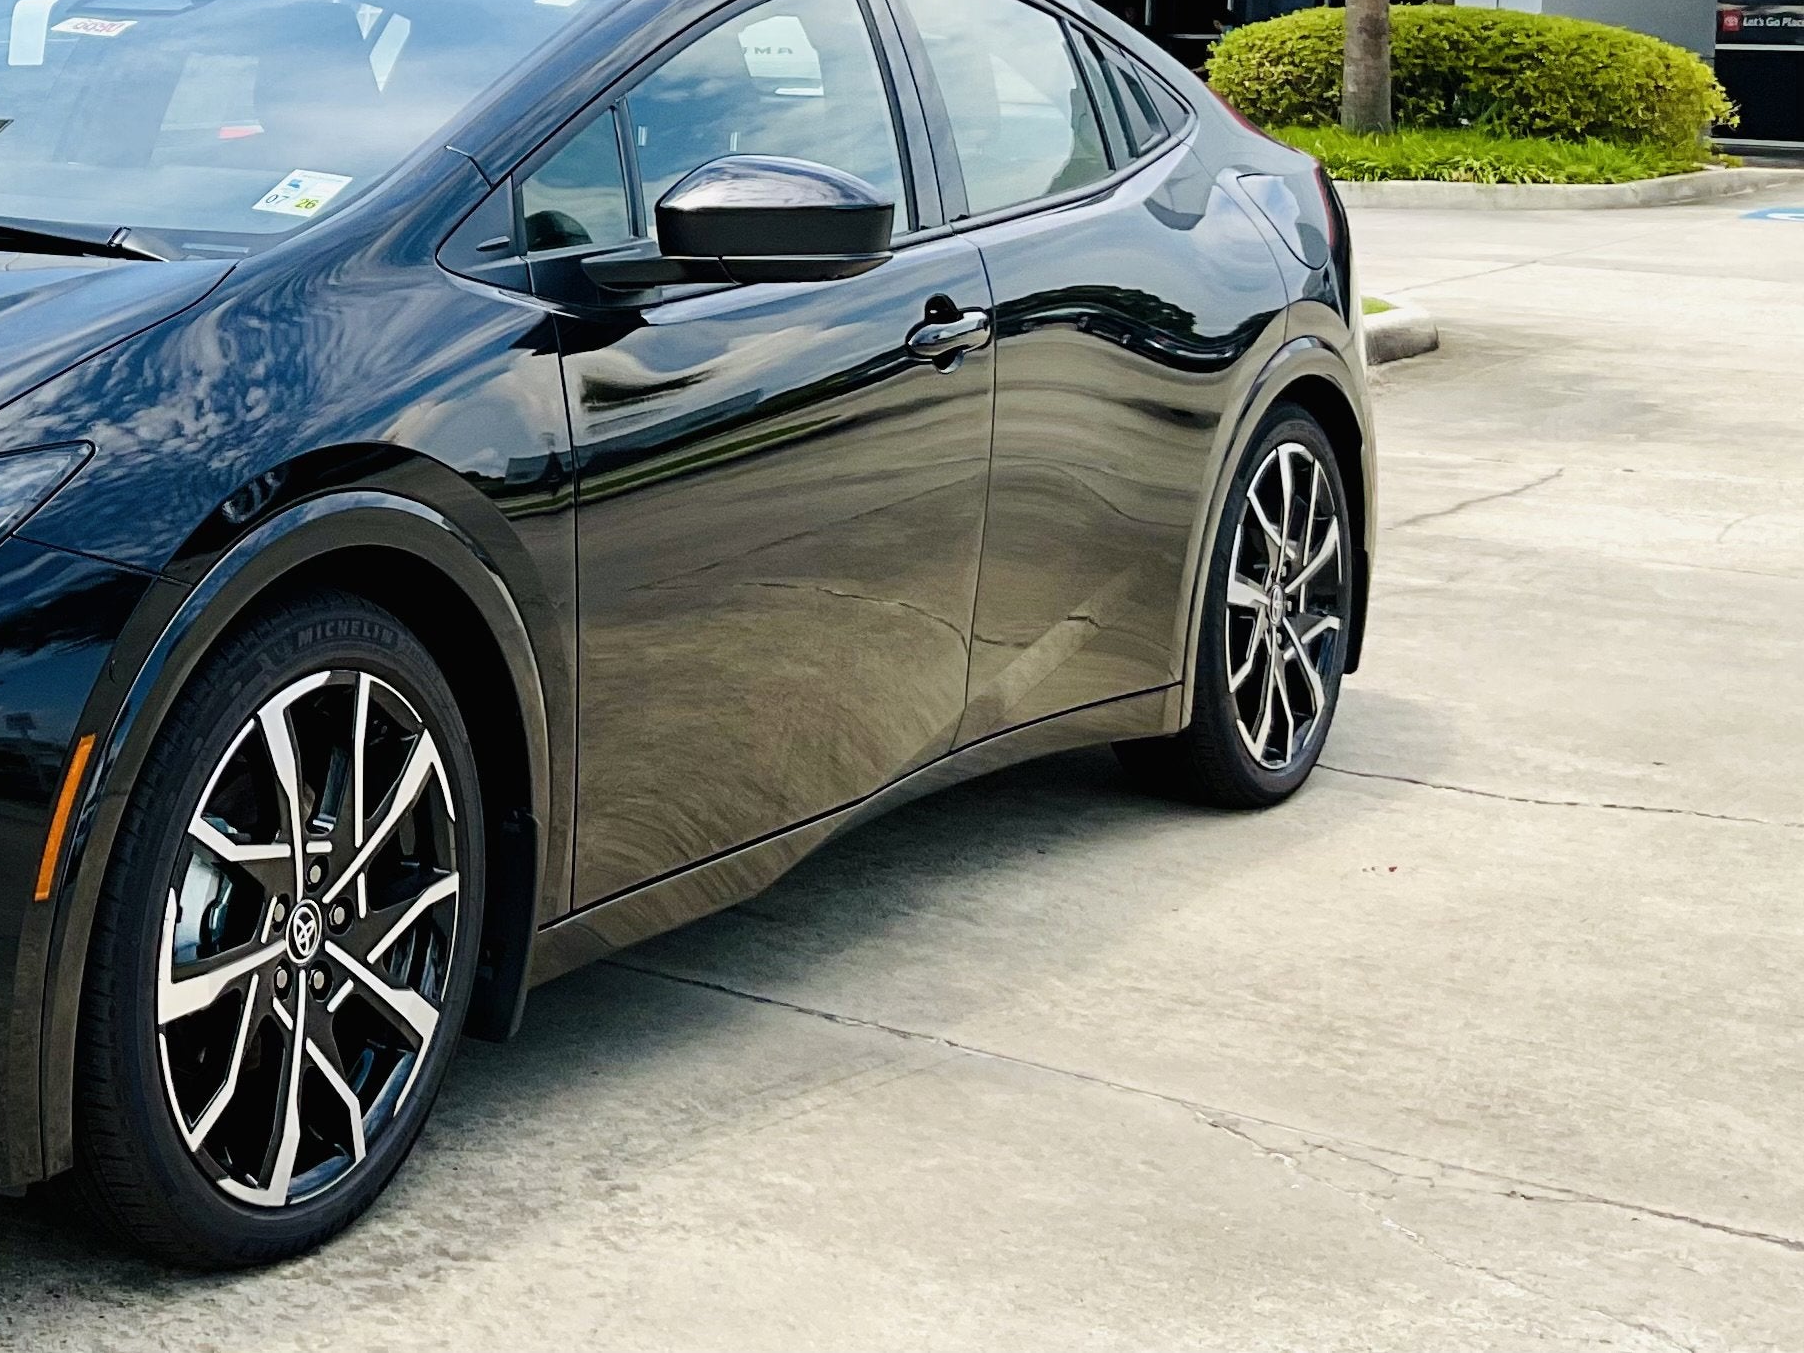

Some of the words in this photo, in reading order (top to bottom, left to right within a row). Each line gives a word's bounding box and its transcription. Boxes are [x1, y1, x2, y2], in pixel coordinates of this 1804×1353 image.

[1743, 17, 1764, 27] Let's
[1766, 17, 1780, 27] Go
[1781, 17, 1804, 27] Plac
[265, 194, 289, 205] 07
[295, 198, 320, 209] 26
[297, 620, 394, 647] MICHELIN
